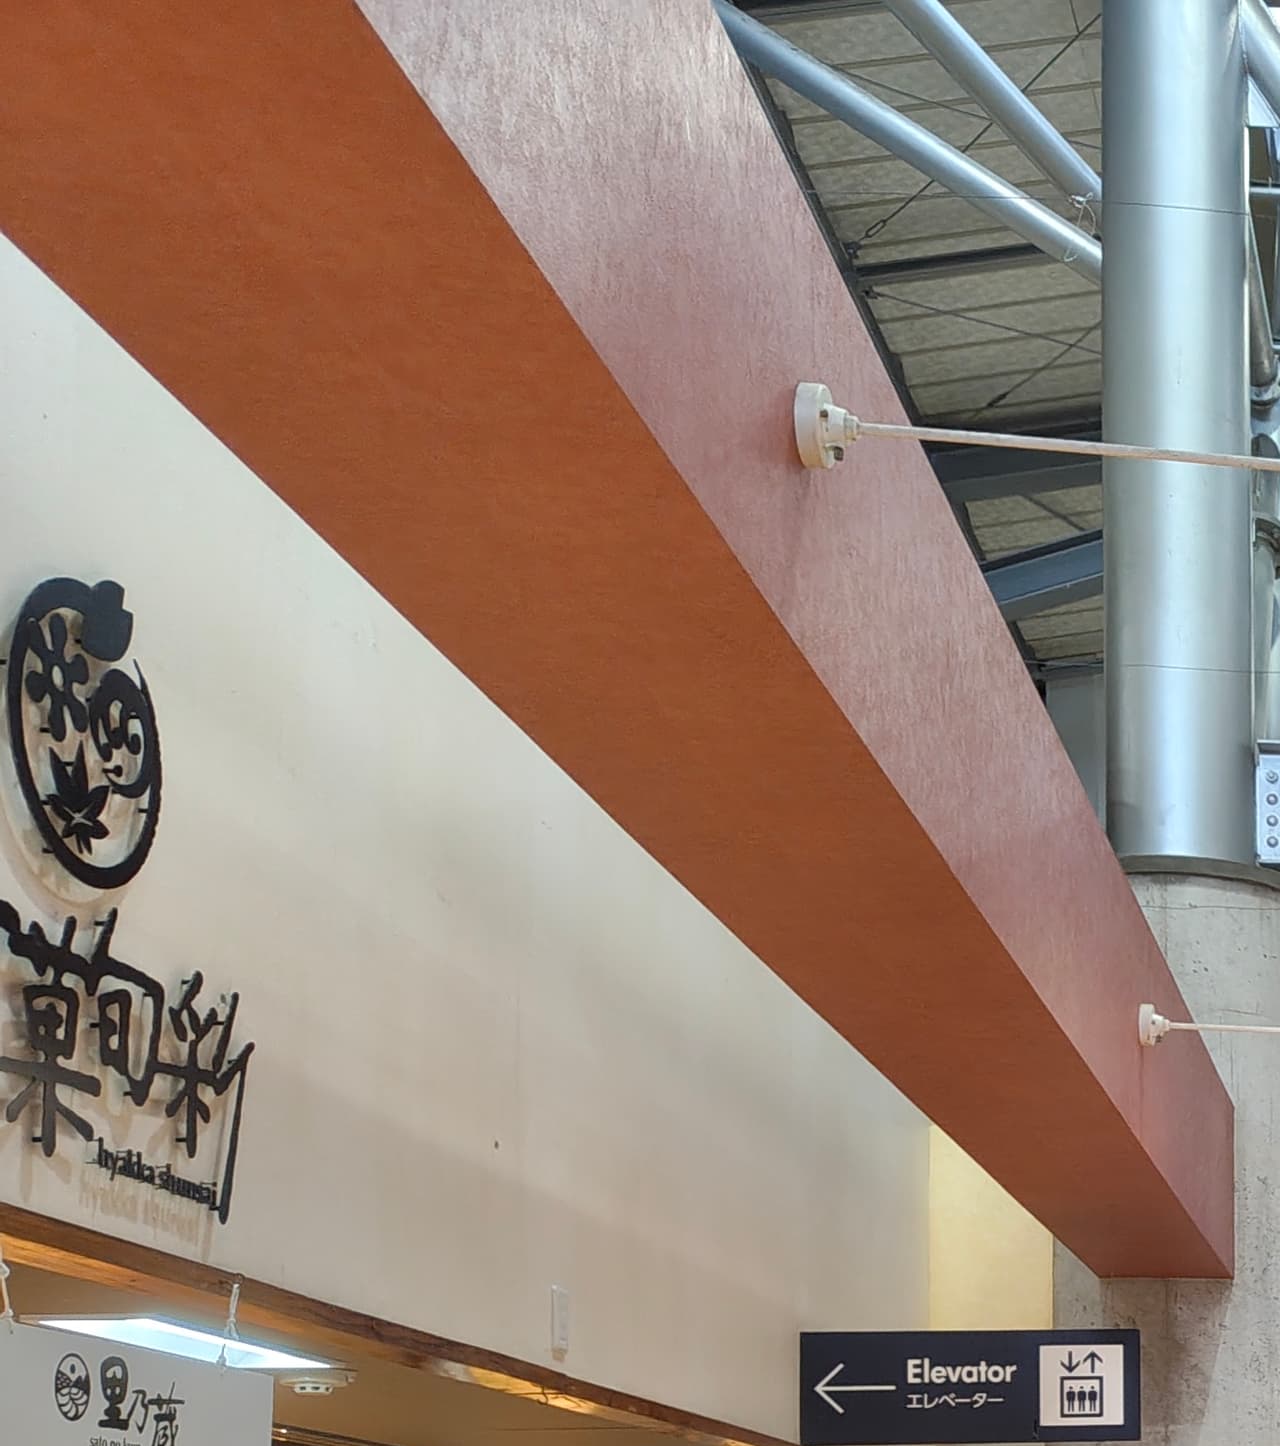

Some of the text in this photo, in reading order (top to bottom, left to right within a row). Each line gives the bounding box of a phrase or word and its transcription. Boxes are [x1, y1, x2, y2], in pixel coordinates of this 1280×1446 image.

[907, 1358, 1017, 1383] Elevator
[906, 1393, 1004, 1408] エレベーター
